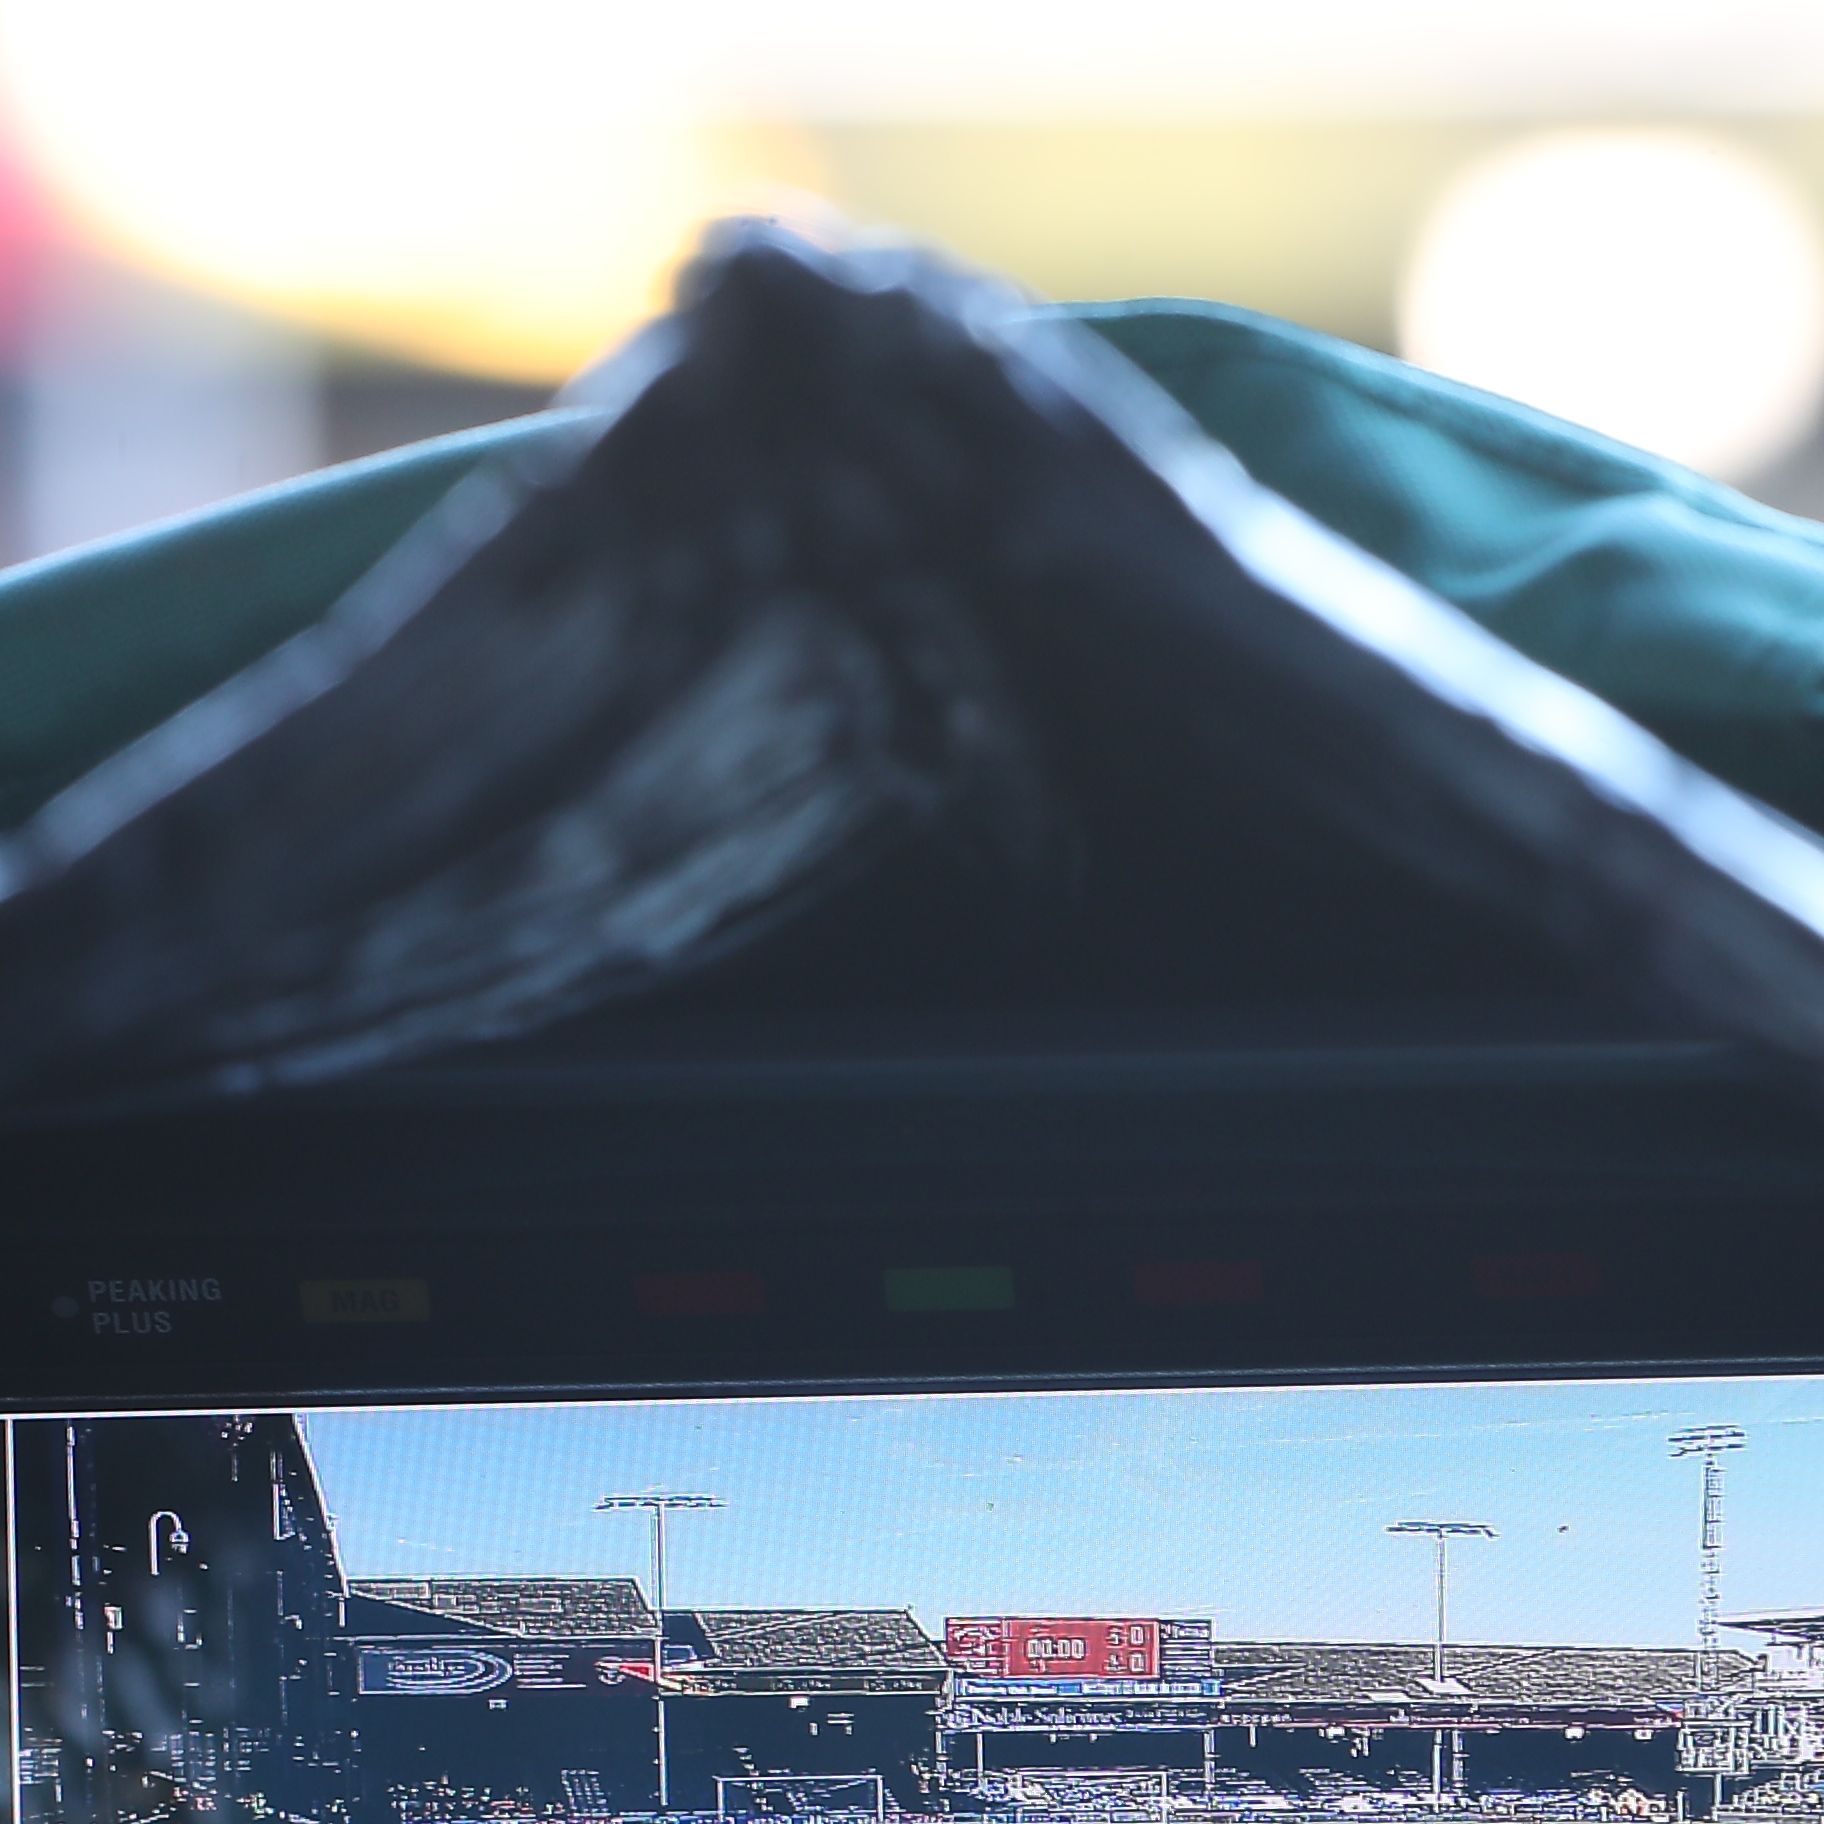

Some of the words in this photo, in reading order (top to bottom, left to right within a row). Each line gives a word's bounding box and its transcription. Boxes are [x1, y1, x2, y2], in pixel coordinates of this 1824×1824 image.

[88, 1279, 221, 1302] PEAKING
[333, 1289, 400, 1313] MAG
[93, 1311, 172, 1334] PLUS
[1027, 1639, 1085, 1659] 00:00
